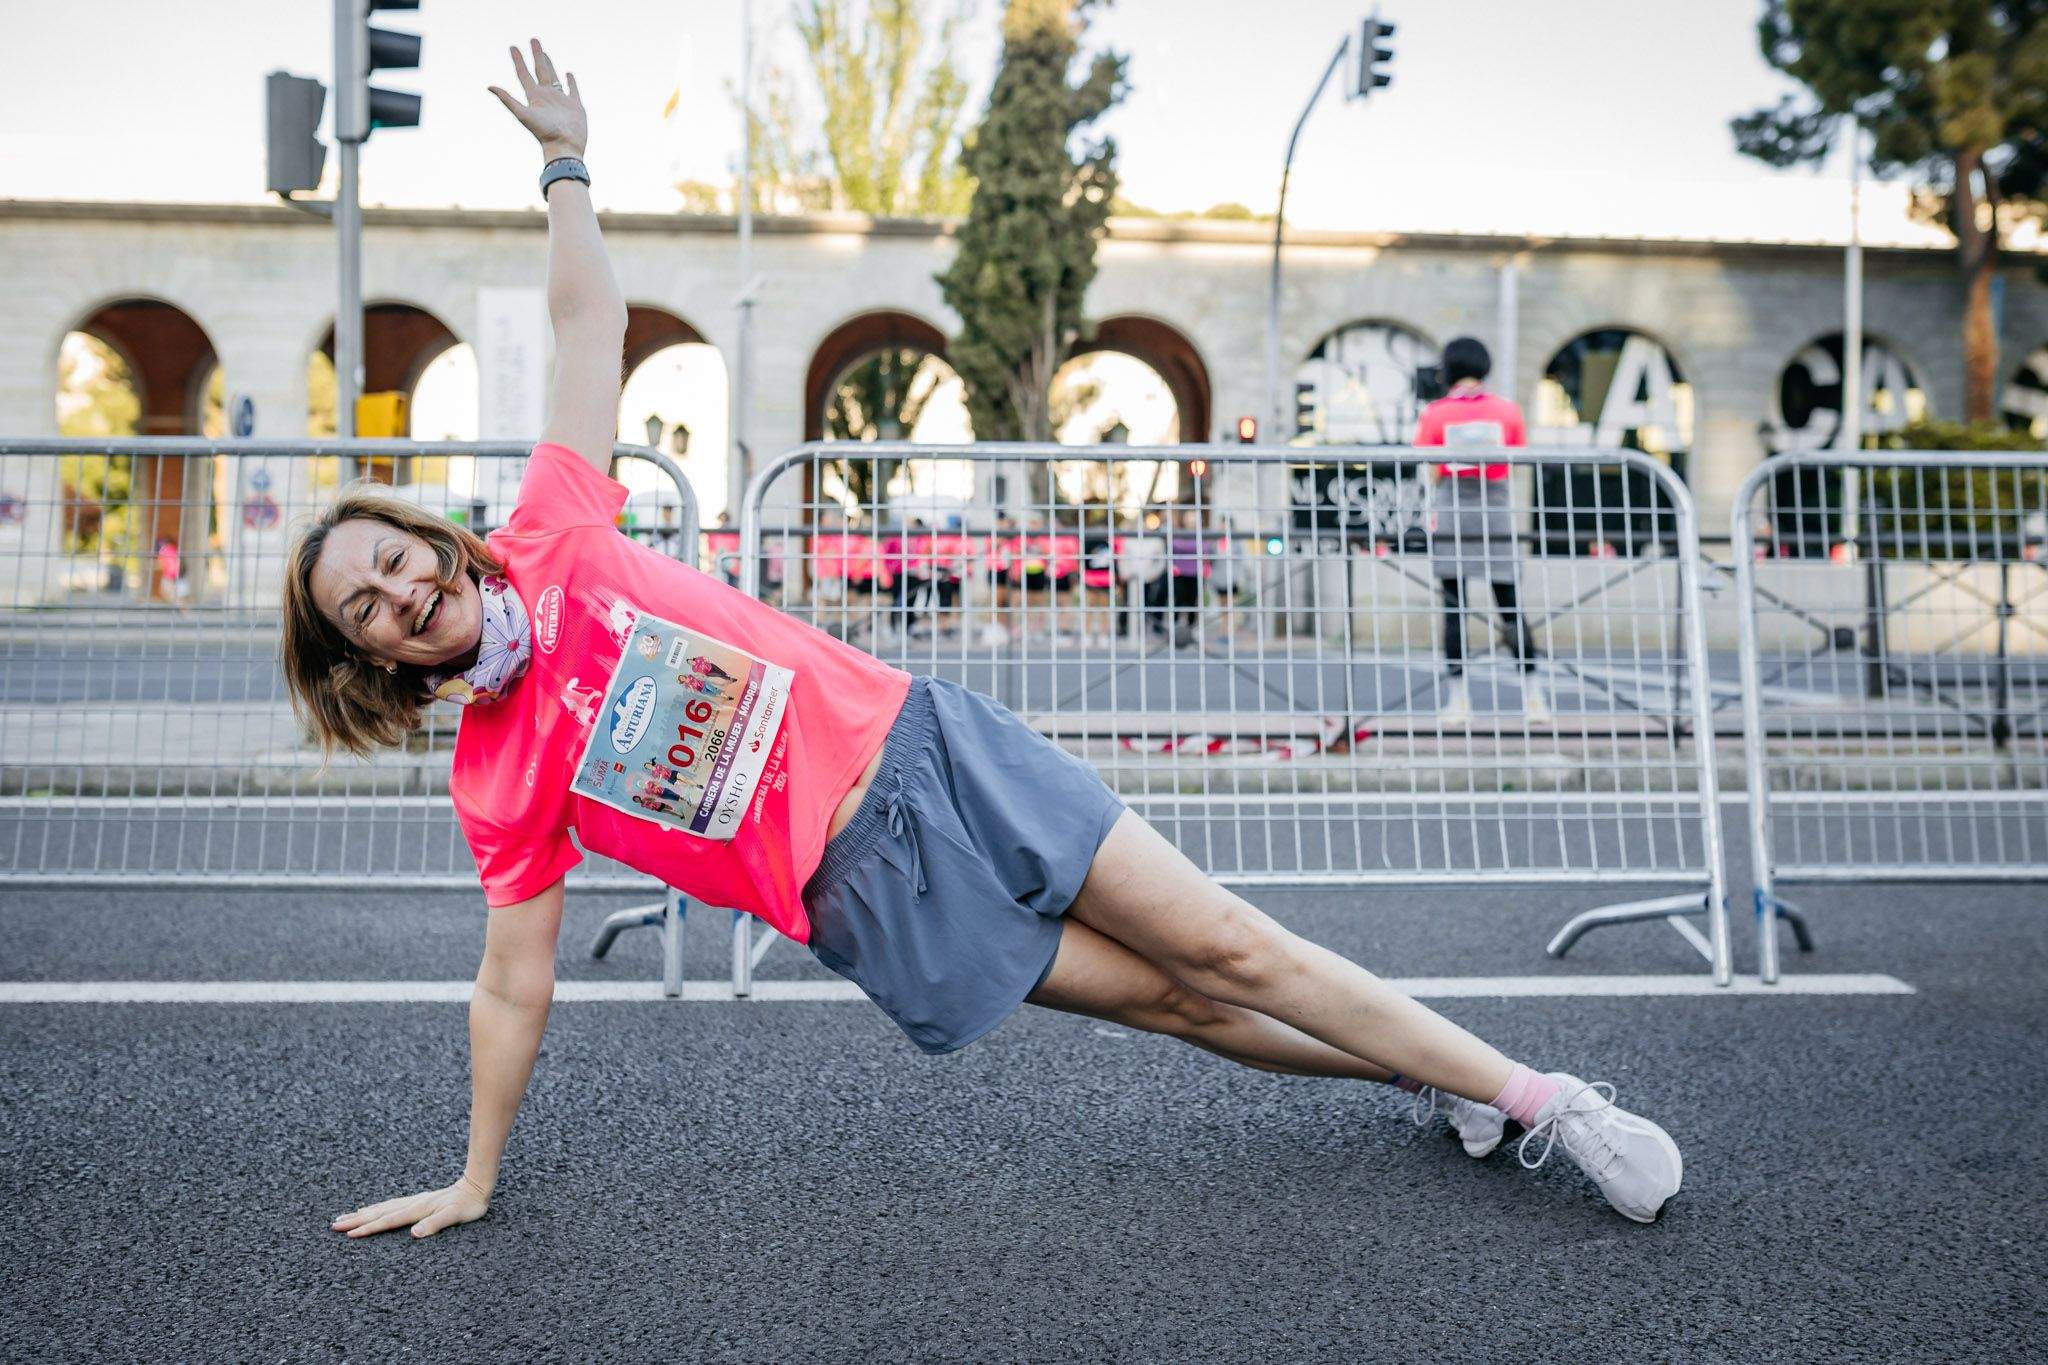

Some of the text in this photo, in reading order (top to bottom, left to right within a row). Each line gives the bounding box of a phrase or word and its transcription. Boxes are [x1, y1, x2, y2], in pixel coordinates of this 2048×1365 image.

[544, 591, 559, 647] ASTURIANA
[617, 683, 654, 750] ASTURIANA
[739, 681, 758, 717] MADRID
[755, 686, 779, 739] Santander
[667, 699, 712, 767] 016
[705, 729, 725, 762] 2066
[725, 722, 743, 753] MUJER
[715, 766, 726, 779] DE
[720, 753, 731, 766] LA
[700, 781, 720, 817] CARRERA
[719, 773, 747, 824] OYSHO
[753, 783, 770, 824] CARRERA
[762, 769, 775, 783] DE
[769, 758, 781, 770] LA
